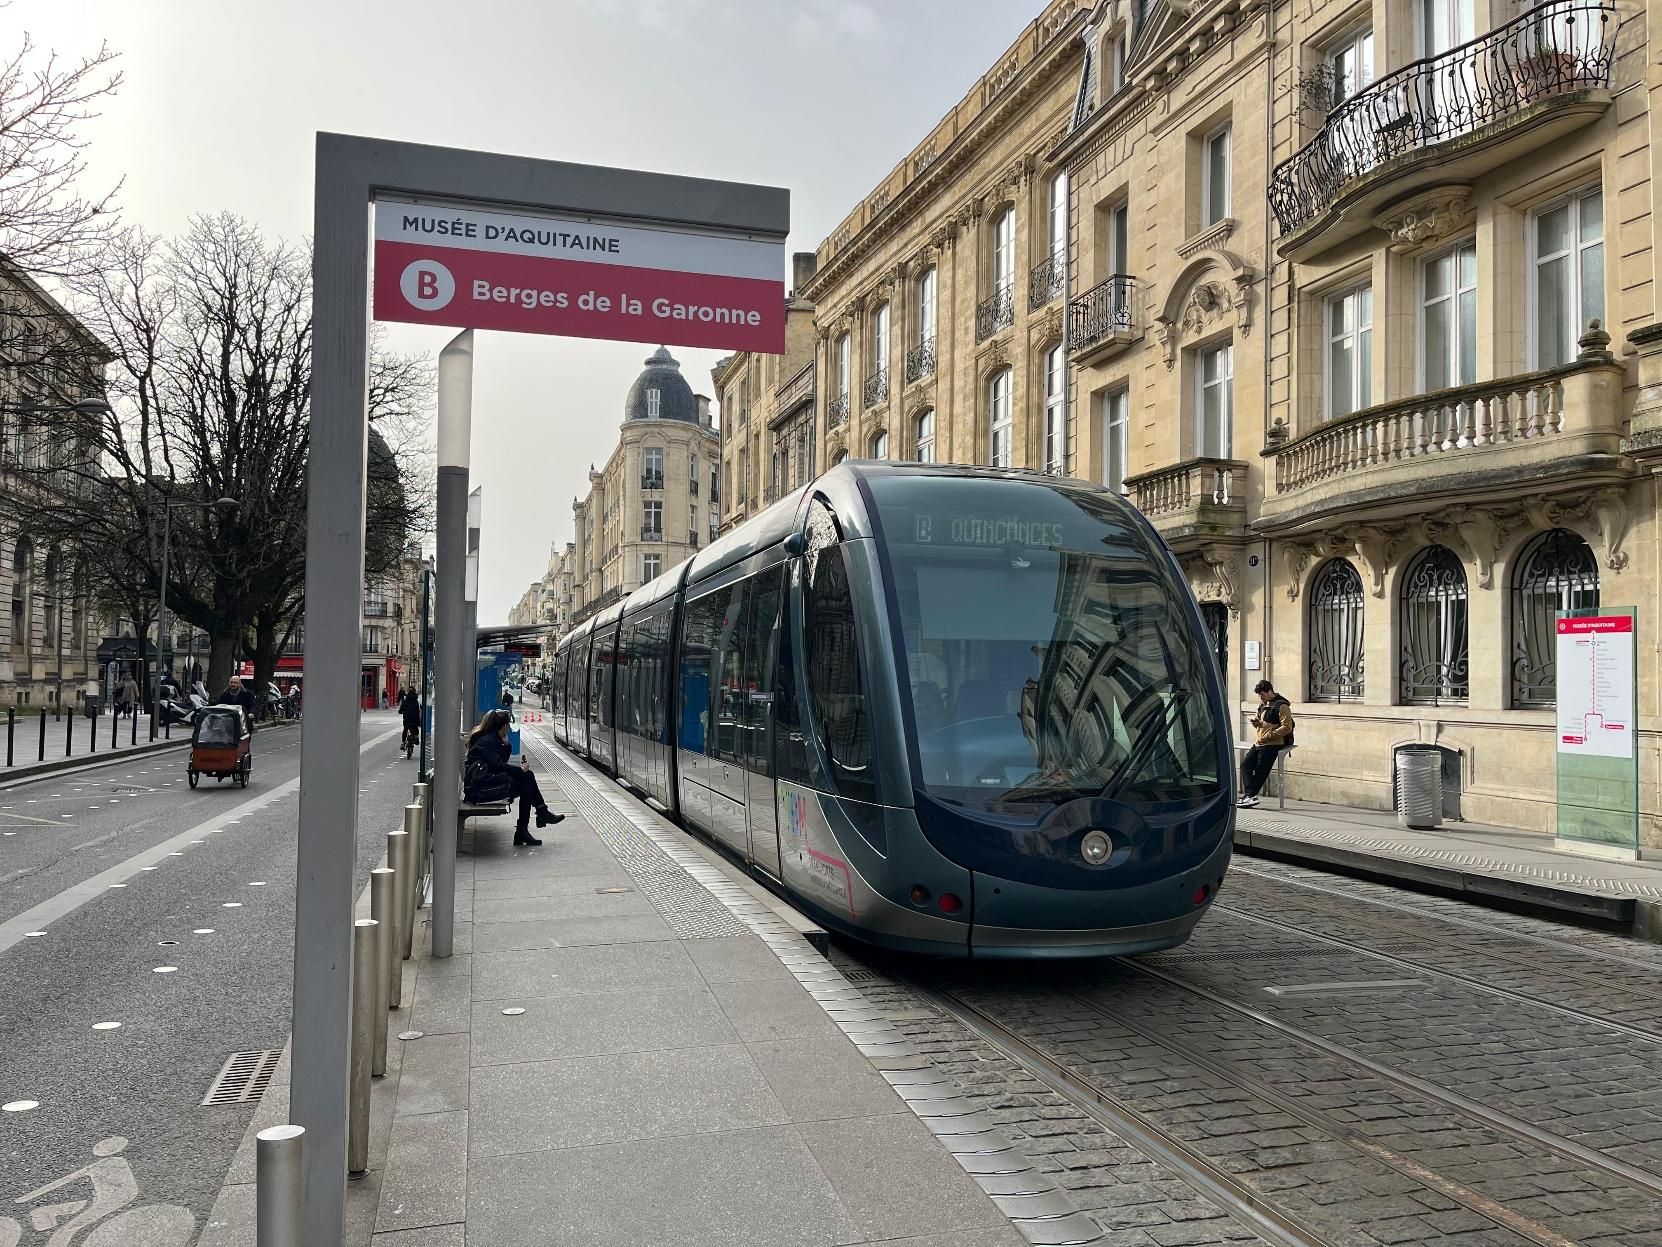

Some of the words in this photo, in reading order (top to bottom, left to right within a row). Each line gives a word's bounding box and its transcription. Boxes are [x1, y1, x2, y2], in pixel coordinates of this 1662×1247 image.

[402, 215, 478, 238] MUSÉE
[484, 225, 621, 253] D'AQUITAINE
[416, 270, 440, 300] B
[472, 279, 569, 310] Berges
[577, 290, 611, 313] de
[620, 294, 643, 316] la
[651, 297, 762, 326] Garonne
